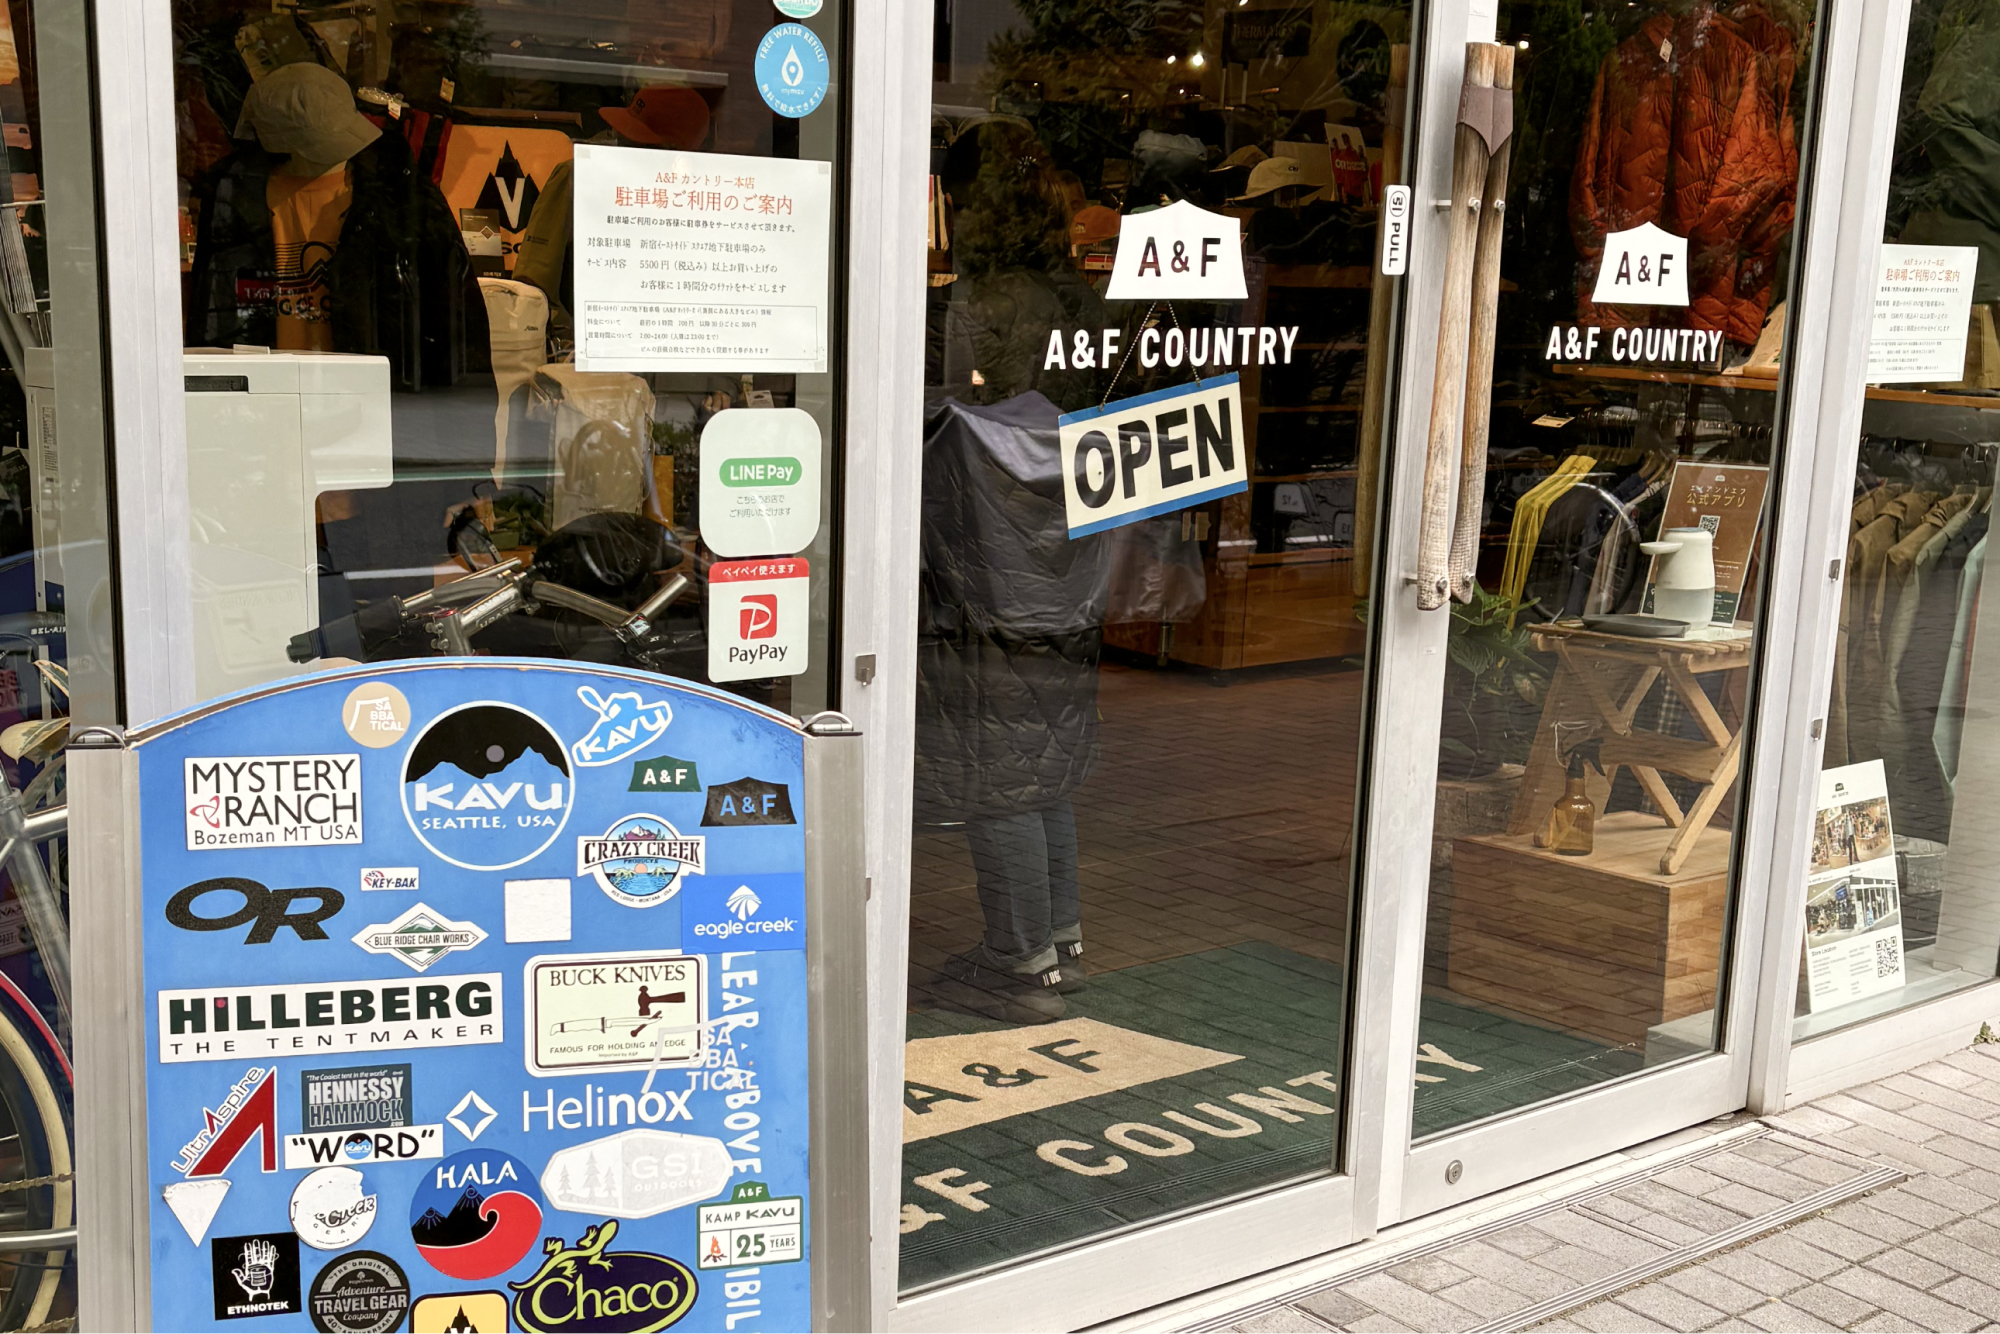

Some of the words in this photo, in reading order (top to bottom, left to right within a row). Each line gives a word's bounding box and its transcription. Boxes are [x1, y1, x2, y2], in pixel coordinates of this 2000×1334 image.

[760, 36, 774, 59] FREE
[773, 26, 802, 39] WATER
[615, 186, 793, 215] 駐車場ご利用のご案内
[1137, 236, 1221, 278] A&F
[1389, 222, 1401, 267] PULL
[1615, 250, 1674, 287] A&F
[1043, 328, 1121, 371] A&F
[1139, 326, 1300, 368] COUNTRY
[1545, 325, 1601, 361] A&F
[1612, 327, 1723, 363] COUNTRY
[1074, 397, 1236, 509] OPEN
[730, 465, 764, 481] LINE
[767, 464, 794, 481] Pay
[736, 495, 785, 505] こちらのお店で
[1686, 492, 1746, 508] 公式アプリ
[729, 508, 791, 518] ご利用いただけます
[722, 564, 796, 577] ペイペイ使えます
[729, 644, 788, 664] PayPay
[370, 721, 405, 732] TICAL
[580, 708, 666, 761] KAVU
[192, 759, 356, 794] MYSTERY
[642, 768, 688, 785] A&F
[415, 782, 564, 811] KAVU
[719, 793, 777, 817] A&F
[224, 792, 358, 827] RANCH
[194, 830, 275, 845] Bozeman
[284, 826, 311, 841] MT
[320, 824, 358, 840] USA
[422, 816, 507, 830] SEATTLE,
[517, 815, 556, 828] USA
[584, 840, 643, 864] CRAZY
[647, 840, 700, 864] CREEK
[371, 877, 417, 889] KEY-BAK
[165, 876, 345, 945] OR
[374, 935, 394, 946] BLUE
[394, 934, 416, 946] RIDGE
[417, 934, 441, 945] CHAIR
[442, 933, 469, 944] WORKS
[694, 919, 744, 939] eagle
[550, 968, 607, 987] BUCK
[614, 965, 686, 984] KNIVES
[169, 981, 493, 1035] HILLEBERG
[170, 1041, 235, 1055] THE
[267, 1024, 494, 1050] TENTMAKER
[550, 1045, 583, 1054] FAMOUS
[587, 1044, 604, 1052] FOR
[607, 1041, 645, 1051] HOLDING
[664, 1039, 686, 1047] EDGE
[308, 1076, 404, 1104] HENNESSY
[309, 1098, 404, 1128] HAMMOCK
[523, 1084, 694, 1132] Helinox
[1036, 1042, 1484, 1177] COUNTY
[436, 1160, 518, 1190] HALA
[632, 1152, 703, 1179] GSI
[738, 1186, 763, 1198] A&F
[705, 1211, 741, 1224] KAMP
[746, 1207, 795, 1220] KAVU
[736, 1233, 766, 1259] 25
[769, 1237, 796, 1248] YEARS
[336, 1285, 386, 1298] Adventure
[532, 1275, 676, 1325] Chaco
[227, 1301, 290, 1315] ETHNOTEK
[314, 1296, 369, 1315] TRAVEL
[369, 1294, 408, 1310] GEAR
[343, 1312, 379, 1322] Company
